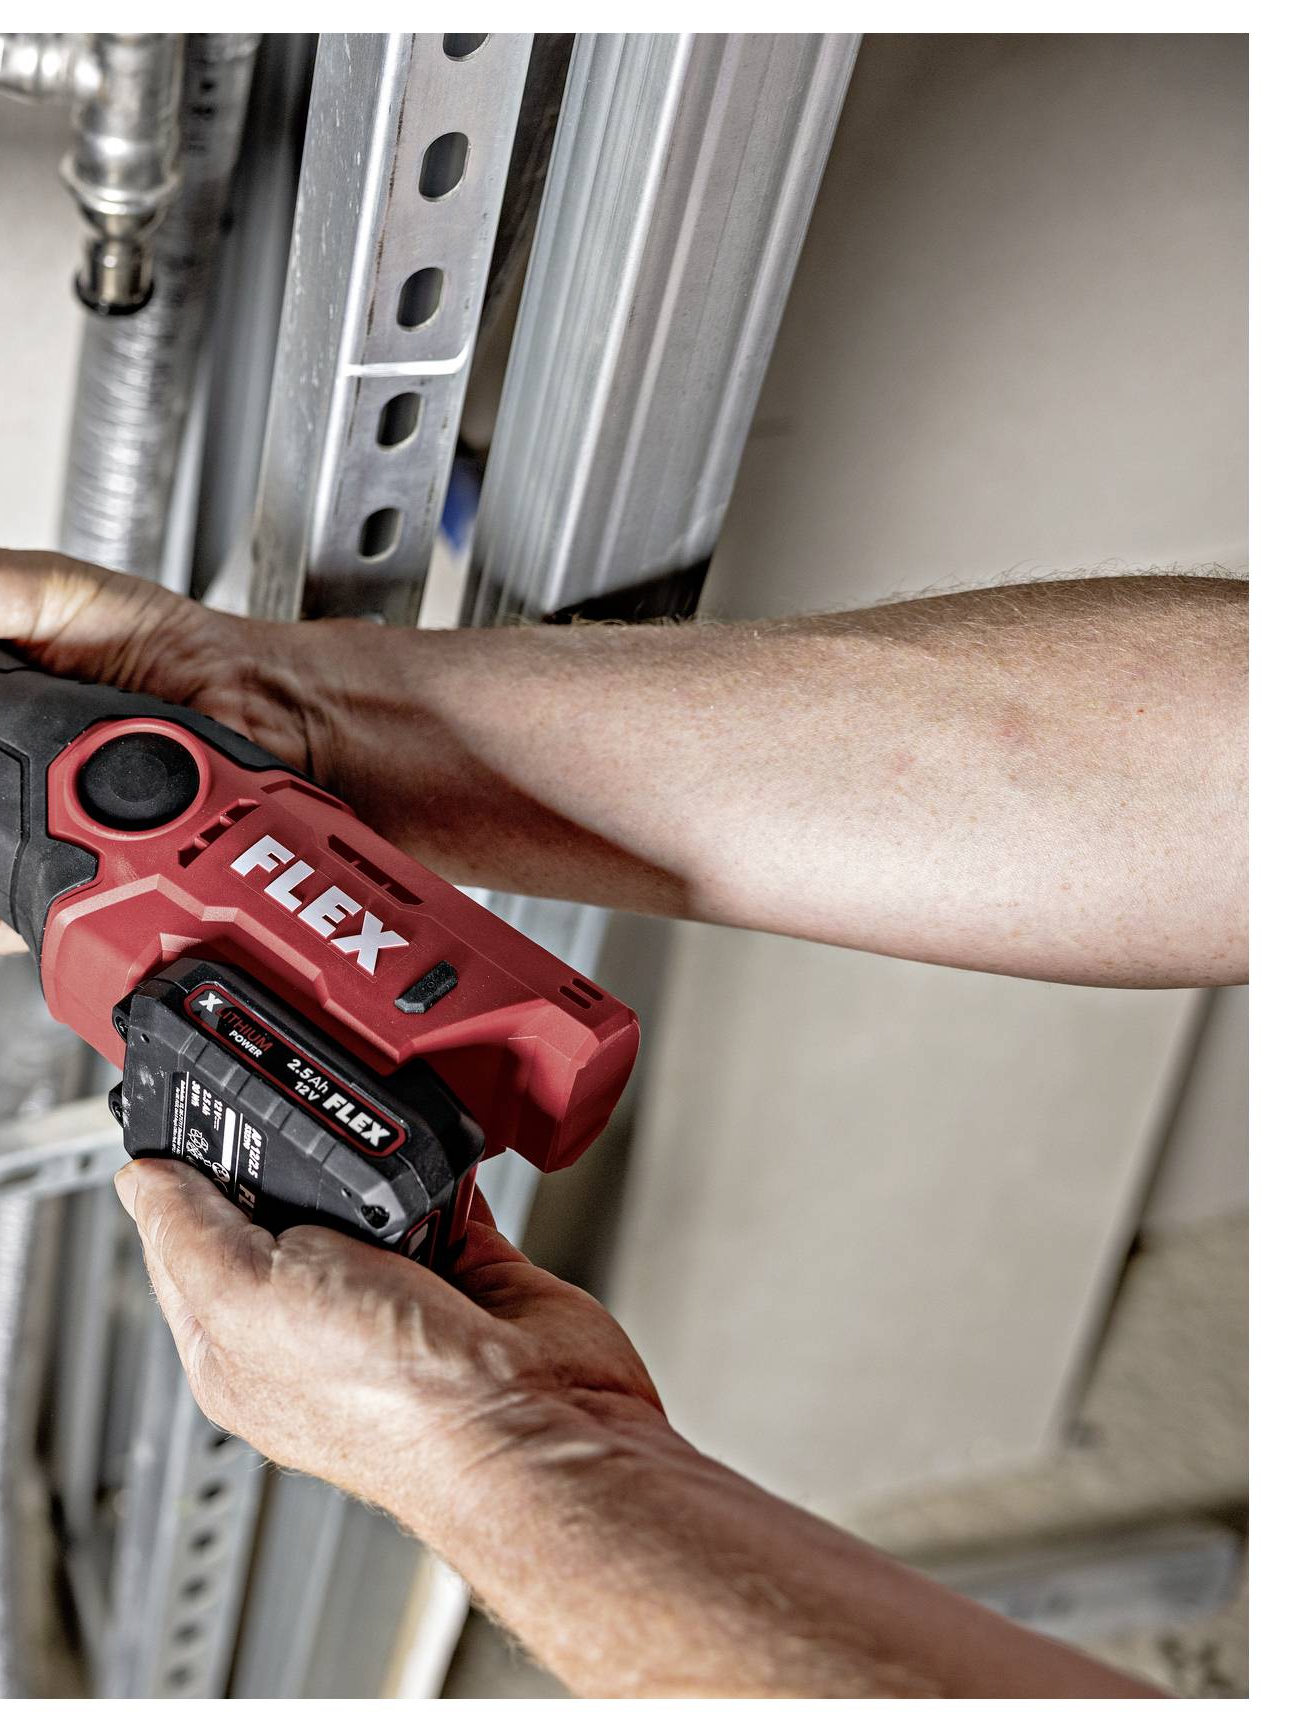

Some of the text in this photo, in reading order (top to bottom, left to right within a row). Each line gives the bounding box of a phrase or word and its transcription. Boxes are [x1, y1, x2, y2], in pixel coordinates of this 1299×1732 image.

[230, 834, 410, 976] FLEX
[198, 991, 274, 1052] X LITHIUM
[228, 1030, 263, 1058] POWER
[286, 1058, 329, 1094] 2.5Ah
[294, 1081, 320, 1102] 12V
[322, 1092, 390, 1148] FLEX
